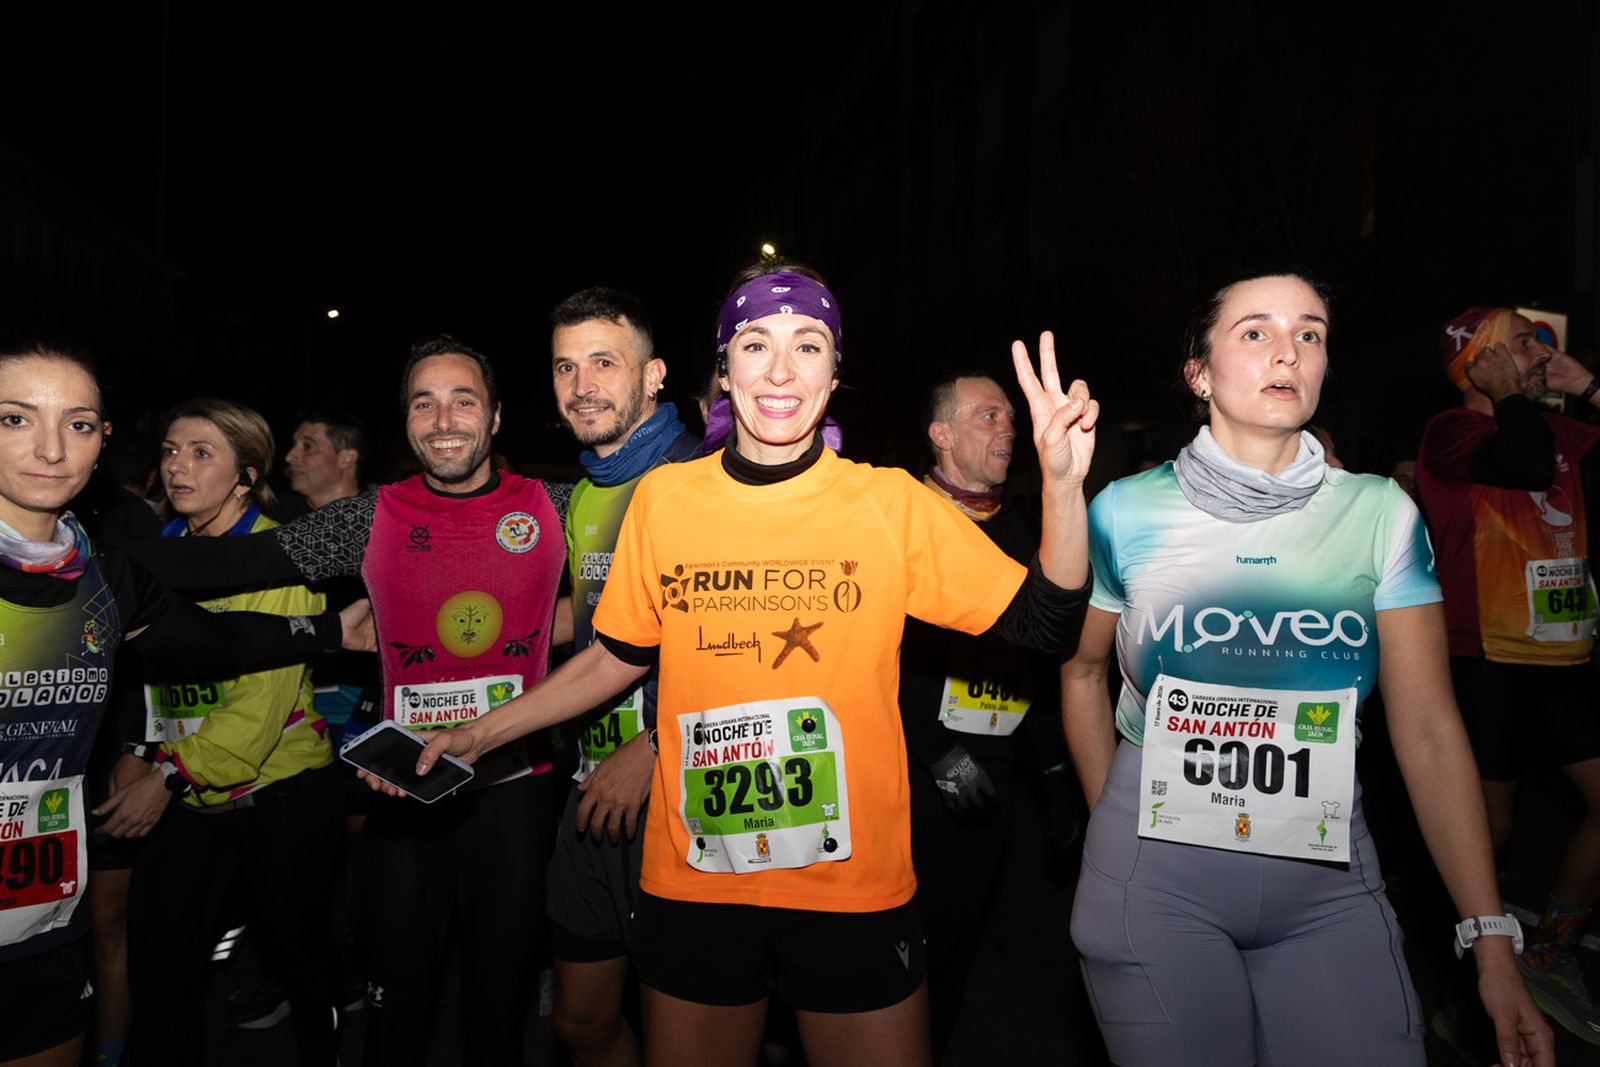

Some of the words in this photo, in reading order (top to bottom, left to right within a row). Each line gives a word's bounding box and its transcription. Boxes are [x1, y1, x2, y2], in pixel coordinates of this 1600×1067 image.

[685, 560, 720, 569] Parkinson's
[722, 559, 760, 567] Community
[762, 559, 810, 567] WORLDWIDE
[811, 559, 835, 567] EVENT
[693, 569, 754, 592] RUN
[764, 569, 826, 590] FOR
[1539, 579, 1557, 588] SAN
[693, 595, 828, 613] PARKINSON'S
[696, 625, 762, 663] Lundbeck
[1222, 647, 1307, 659] RUNNING
[1321, 651, 1360, 660] CLUB
[422, 696, 459, 708] NOCHE
[461, 693, 476, 705] DE
[1168, 692, 1187, 707] 43
[409, 712, 432, 725] SAN
[435, 705, 478, 723] ANTÓN
[1191, 701, 1251, 717] NOCHE
[1254, 705, 1278, 718] DE
[703, 723, 748, 745] NOCHE
[753, 720, 772, 737] DE
[1167, 716, 1206, 735] SAN
[1209, 717, 1276, 739] ANTÓN
[692, 748, 718, 768] SAN
[722, 737, 774, 764] ANTÓN
[1183, 737, 1311, 799] 6001
[703, 757, 813, 818] 3293
[1211, 792, 1246, 808] Maria
[8, 801, 30, 818] DE
